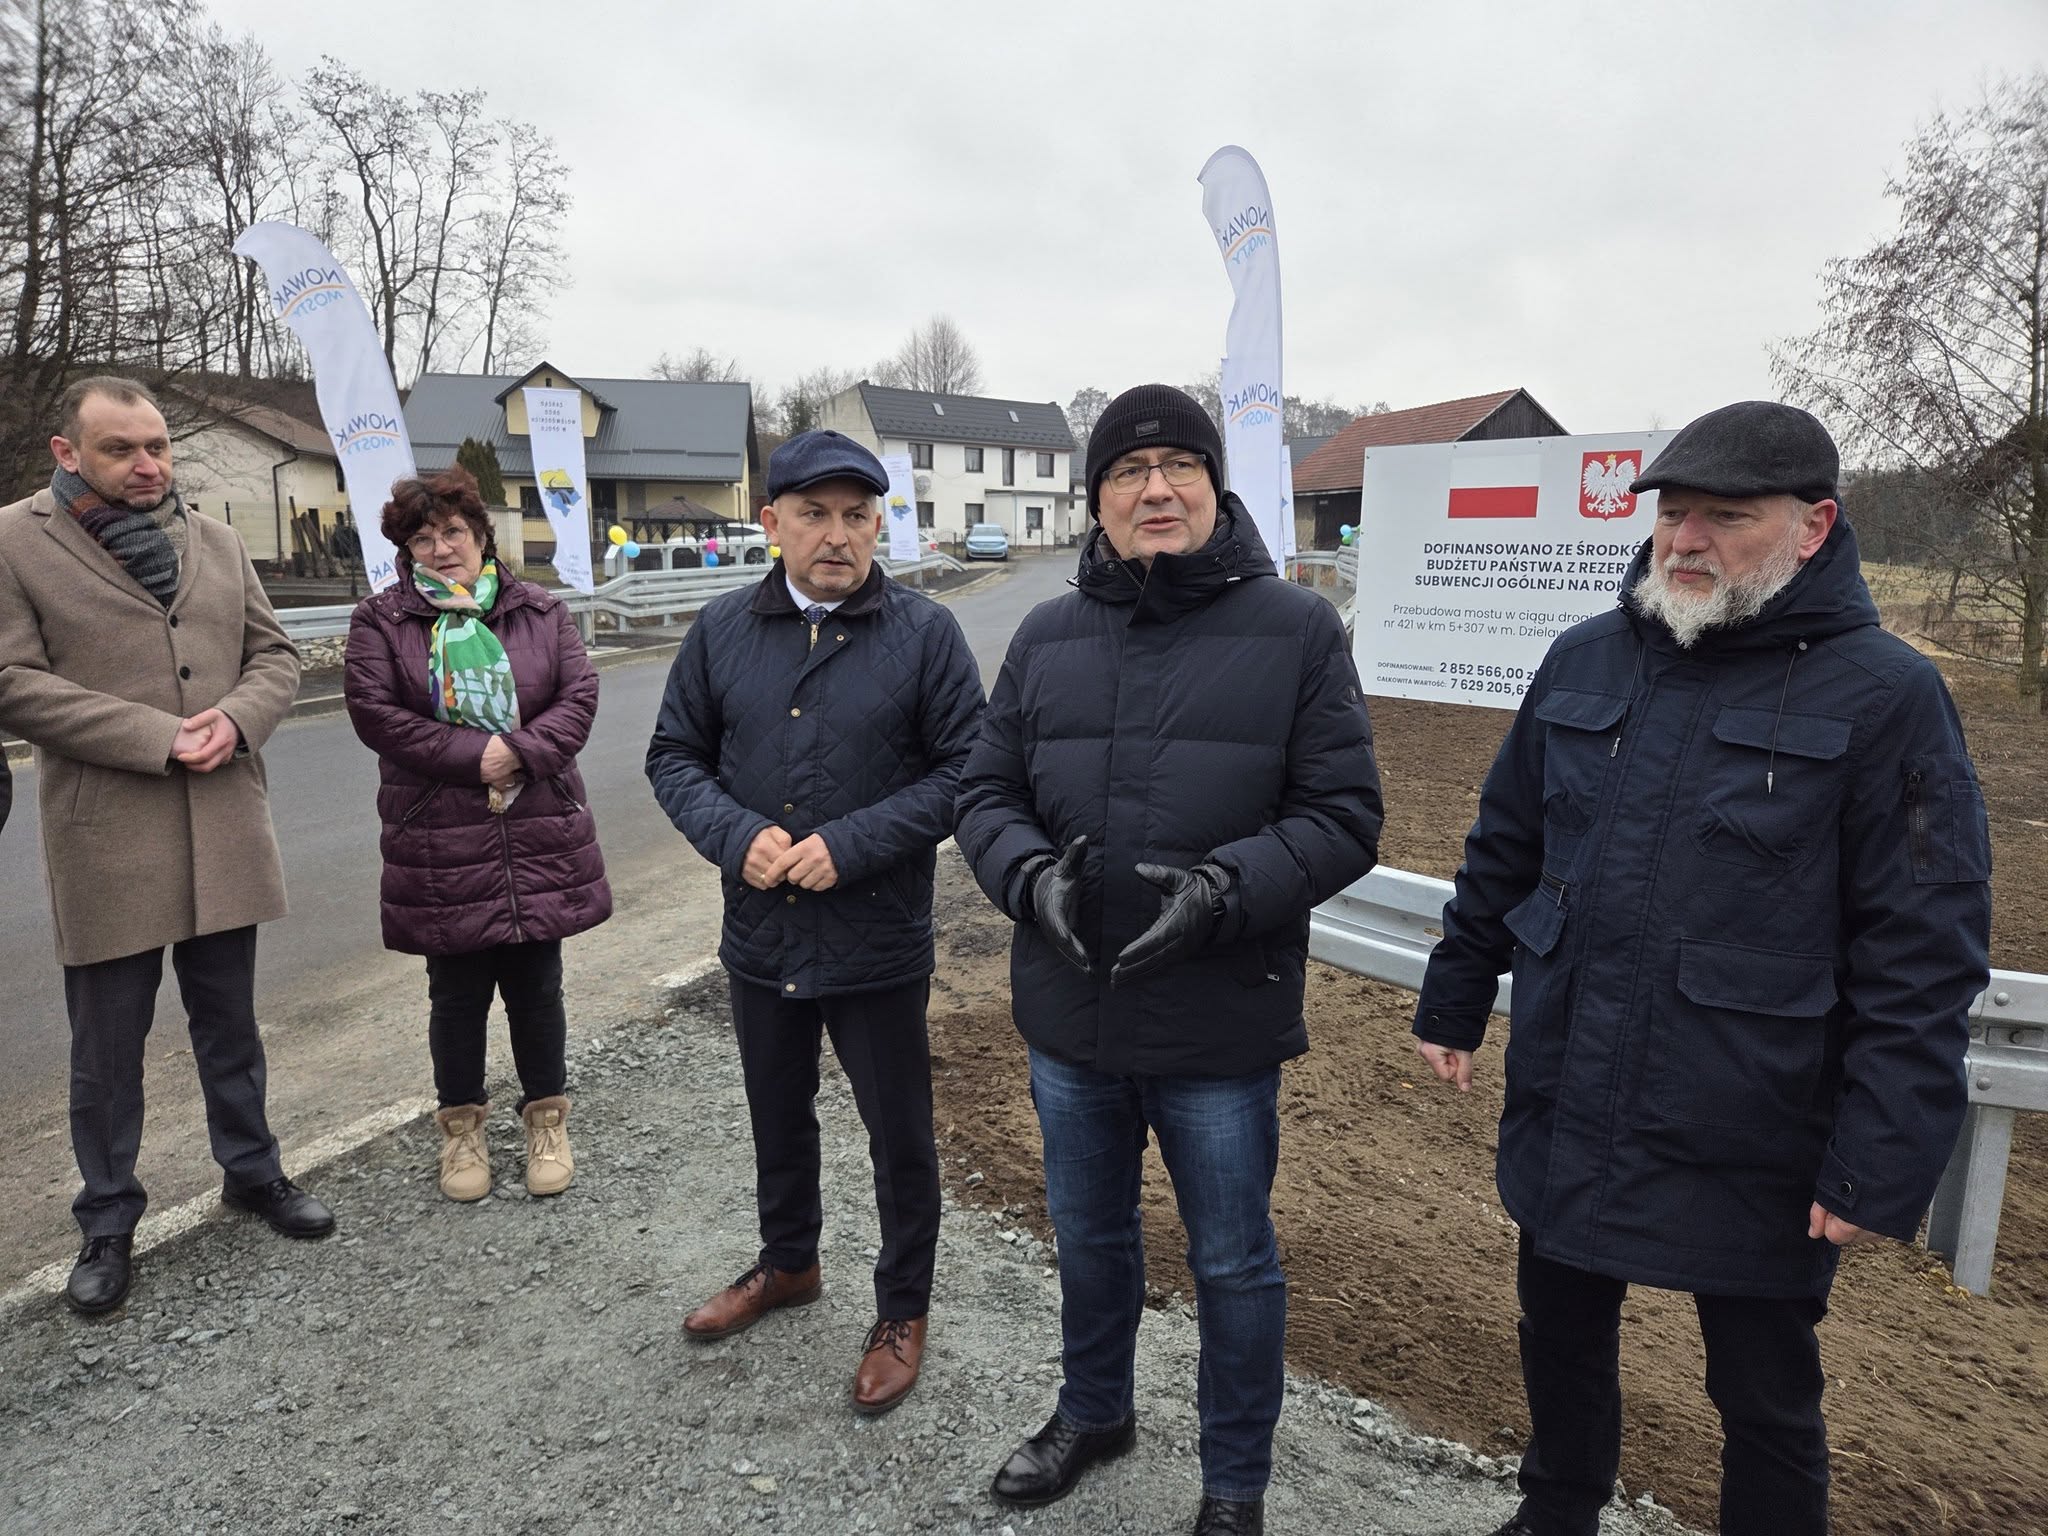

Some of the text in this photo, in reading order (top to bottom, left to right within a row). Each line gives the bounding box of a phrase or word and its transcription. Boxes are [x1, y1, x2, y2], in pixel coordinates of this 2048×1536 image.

[1423, 540, 1643, 556] DOFINANSOWANO ZE ŚRODKÓ
[1427, 557, 1630, 574] BUDŻETU PAŃSTWA Z REZER
[1415, 575, 1494, 588] SUBWENCJI
[1497, 575, 1564, 590] OGÓLNEJ
[1568, 579, 1590, 591] NA
[1393, 604, 1462, 617] Przebudowa
[1465, 609, 1502, 619] mostu
[1505, 611, 1516, 620] w
[1519, 610, 1555, 625] ciągu
[1384, 619, 1395, 628] nr
[1398, 619, 1414, 629] 421
[1416, 622, 1426, 630] w
[1428, 620, 1446, 631] km
[1449, 621, 1485, 634] 5+307
[1487, 625, 1498, 635] w
[1500, 627, 1516, 636] m.
[1440, 662, 1447, 673] 2
[1450, 662, 1474, 675] 852
[1477, 665, 1524, 680] 566,00
[1526, 669, 1538, 680] z
[1451, 678, 1458, 689] 7
[1460, 679, 1484, 691] 629
